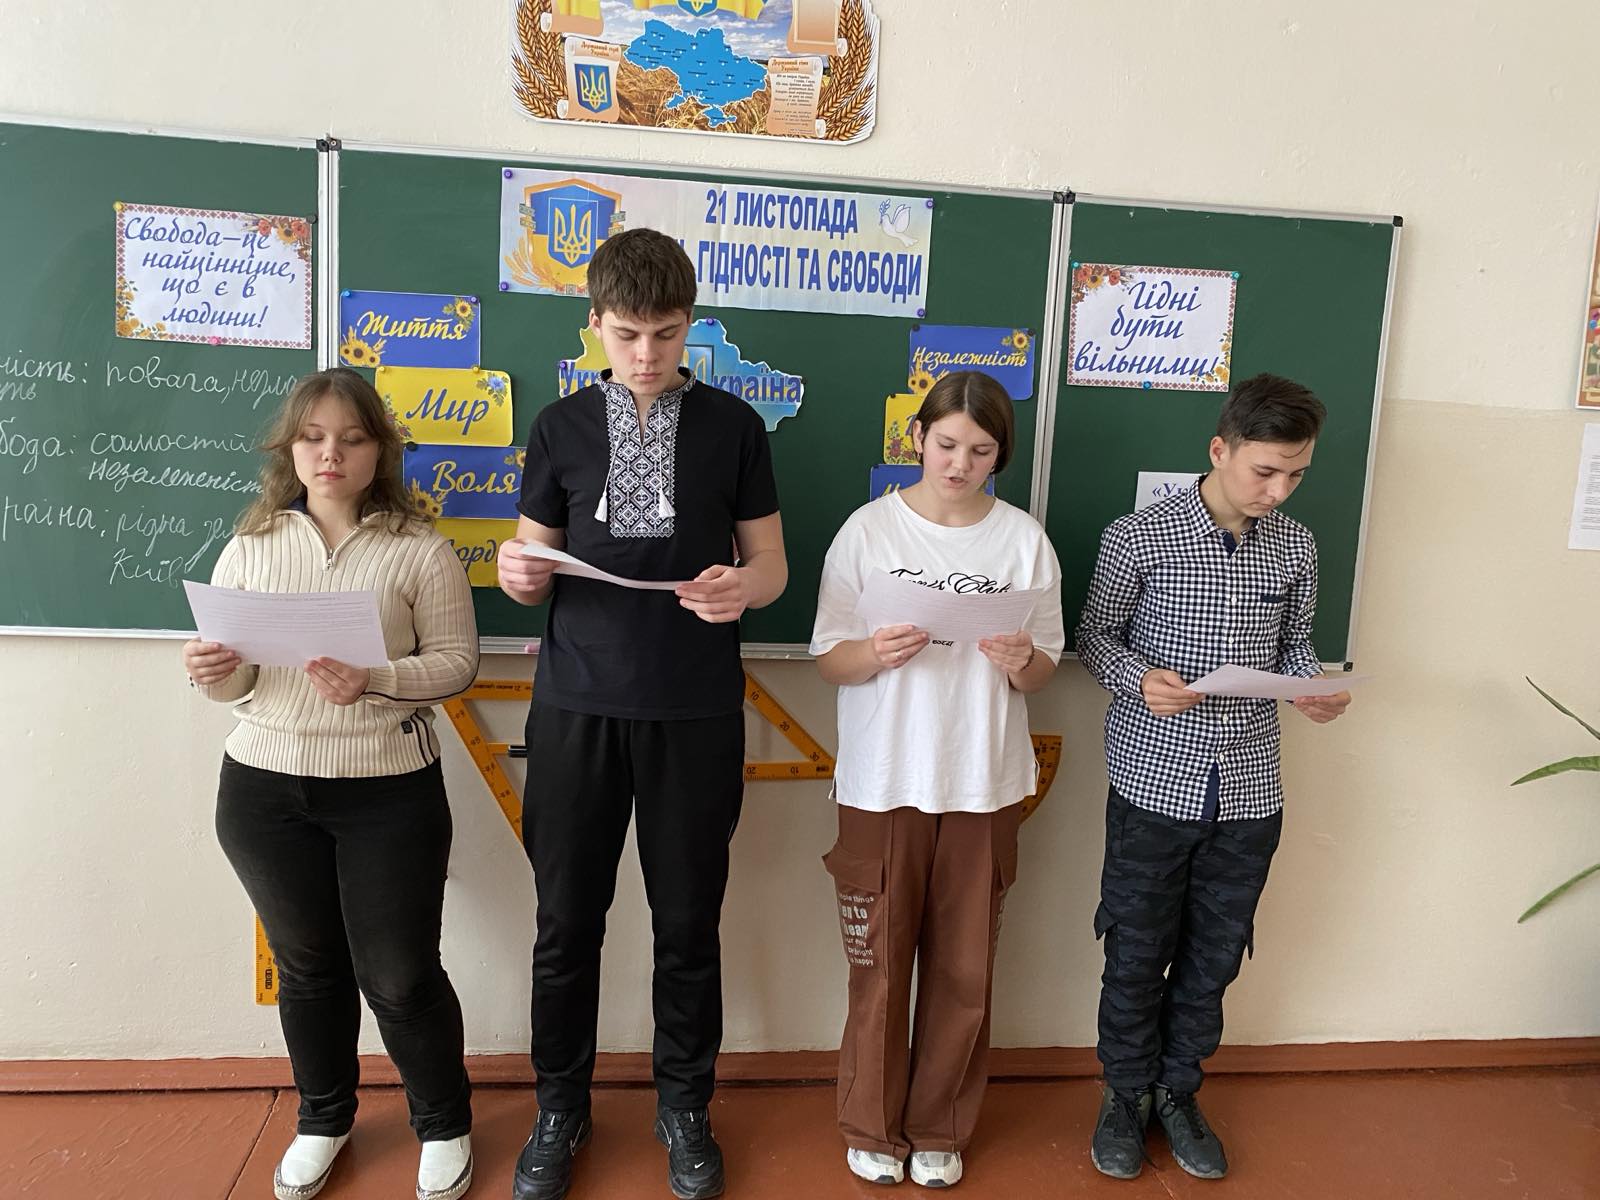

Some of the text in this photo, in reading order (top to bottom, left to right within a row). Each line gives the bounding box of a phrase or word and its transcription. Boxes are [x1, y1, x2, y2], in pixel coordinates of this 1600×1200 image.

[705, 189, 858, 240] 21 ЛИСТОПАДА
[142, 249, 296, 284] найцінніше,
[697, 240, 922, 304] ГІДНОСТІ ТА СВОБОДИ
[162, 274, 257, 304] що є в
[1128, 280, 1202, 312] Гідні
[162, 301, 269, 329] людини!
[357, 310, 467, 341] Життя
[1110, 304, 1184, 351] бути
[912, 346, 1027, 371] Незалежність
[1074, 341, 1219, 377] вільними!
[405, 388, 490, 436] Мир
[89, 457, 264, 492] незалежніст
[432, 460, 520, 495] Воля
